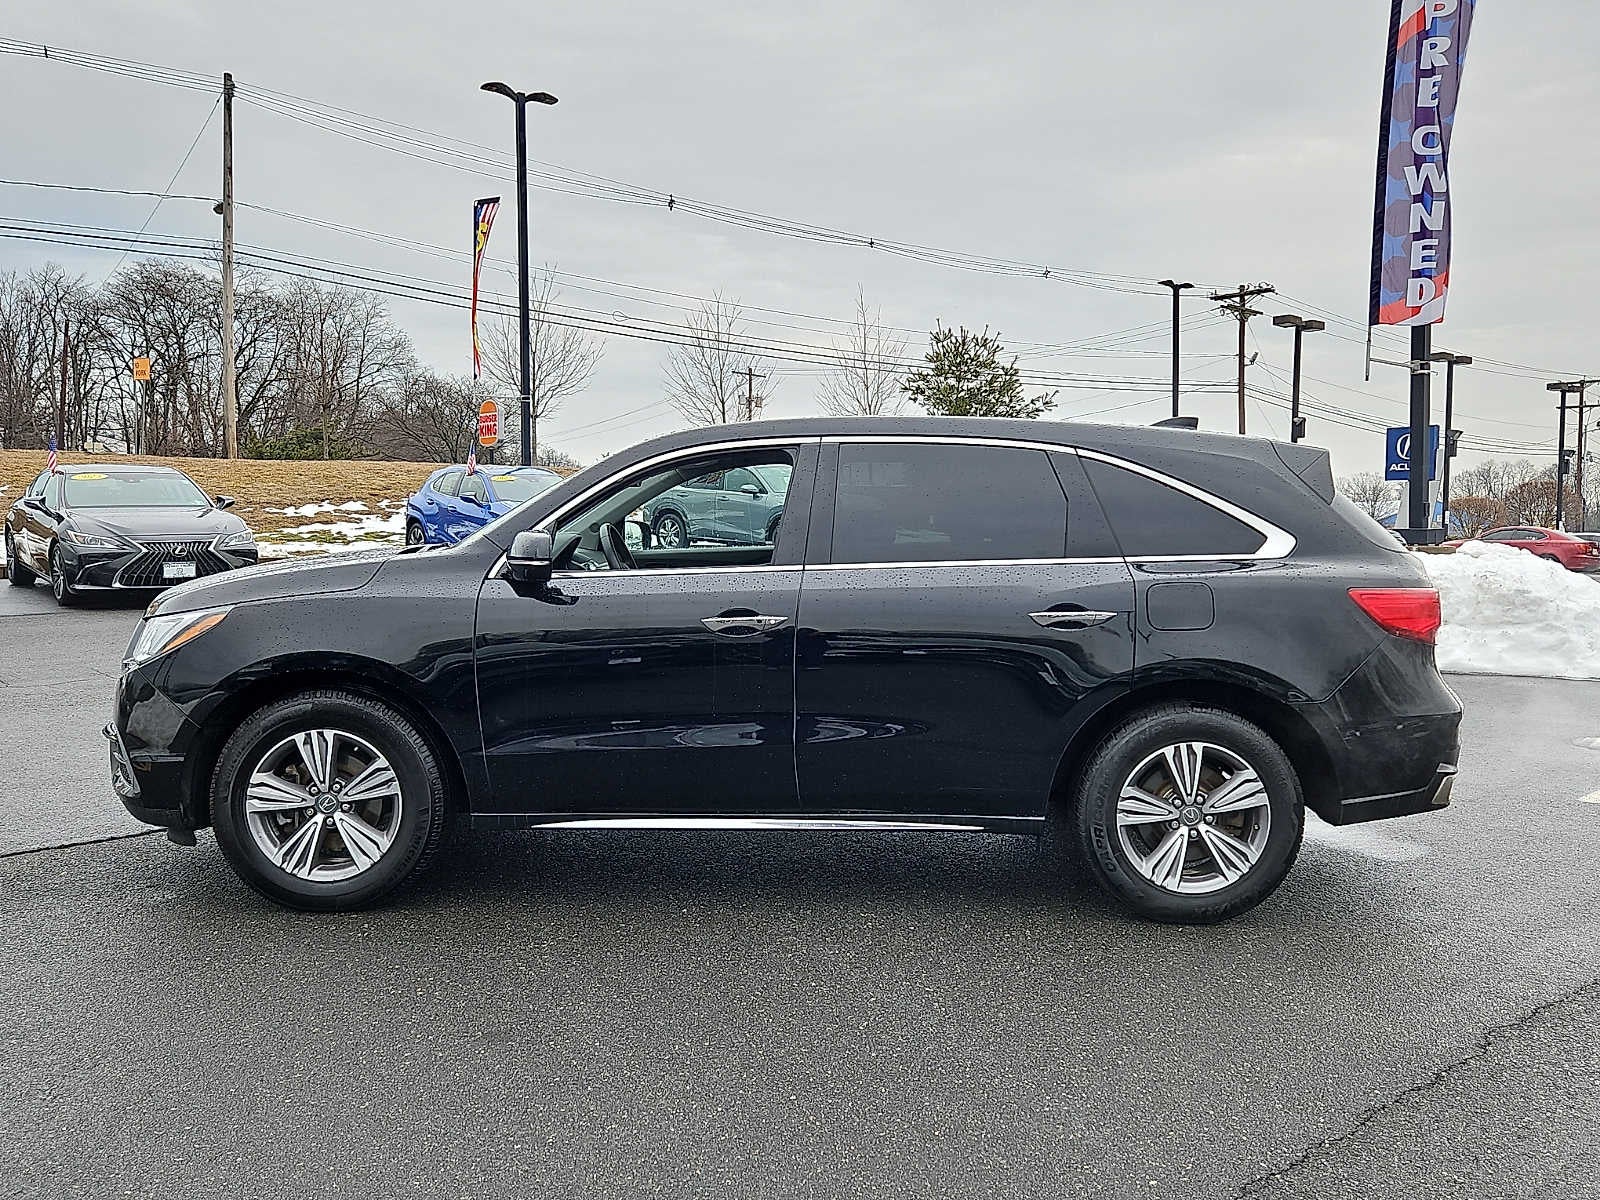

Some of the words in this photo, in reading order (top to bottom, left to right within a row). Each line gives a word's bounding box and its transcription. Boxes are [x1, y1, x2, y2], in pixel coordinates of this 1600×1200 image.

[1416, 0, 1457, 108] PRE
[1403, 125, 1448, 308] OWNED
[479, 423, 498, 437] KING
